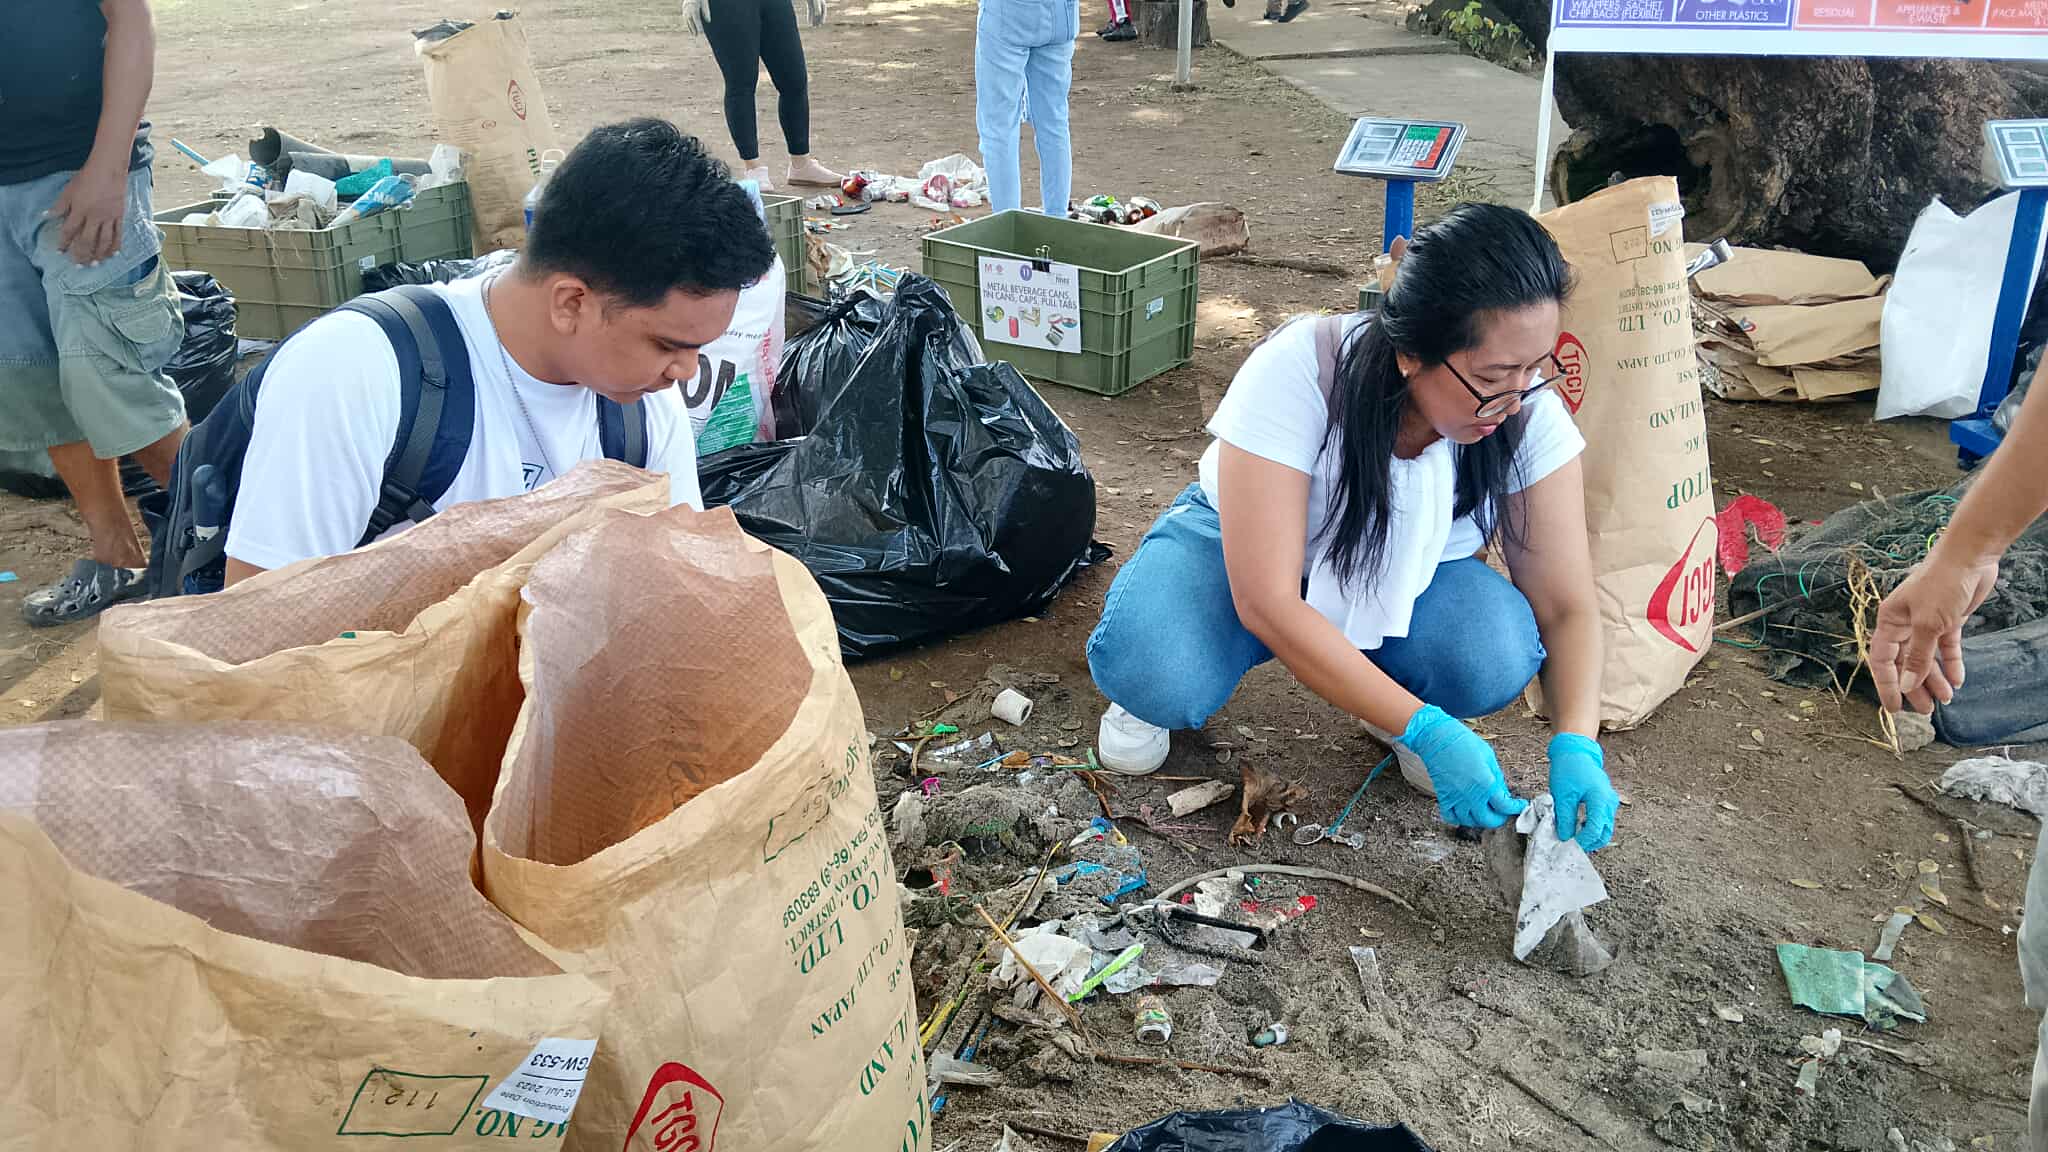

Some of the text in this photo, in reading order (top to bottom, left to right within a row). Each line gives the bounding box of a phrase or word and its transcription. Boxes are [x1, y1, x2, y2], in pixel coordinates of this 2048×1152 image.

[1695, 11, 1769, 22] OTHER PLASTICS
[986, 281, 1009, 293] METAL
[1009, 284, 1047, 296] BEVERAGE
[1561, 350, 1583, 395] TGCI
[1679, 555, 1715, 628] GCI
[530, 1053, 590, 1072] GW-533
